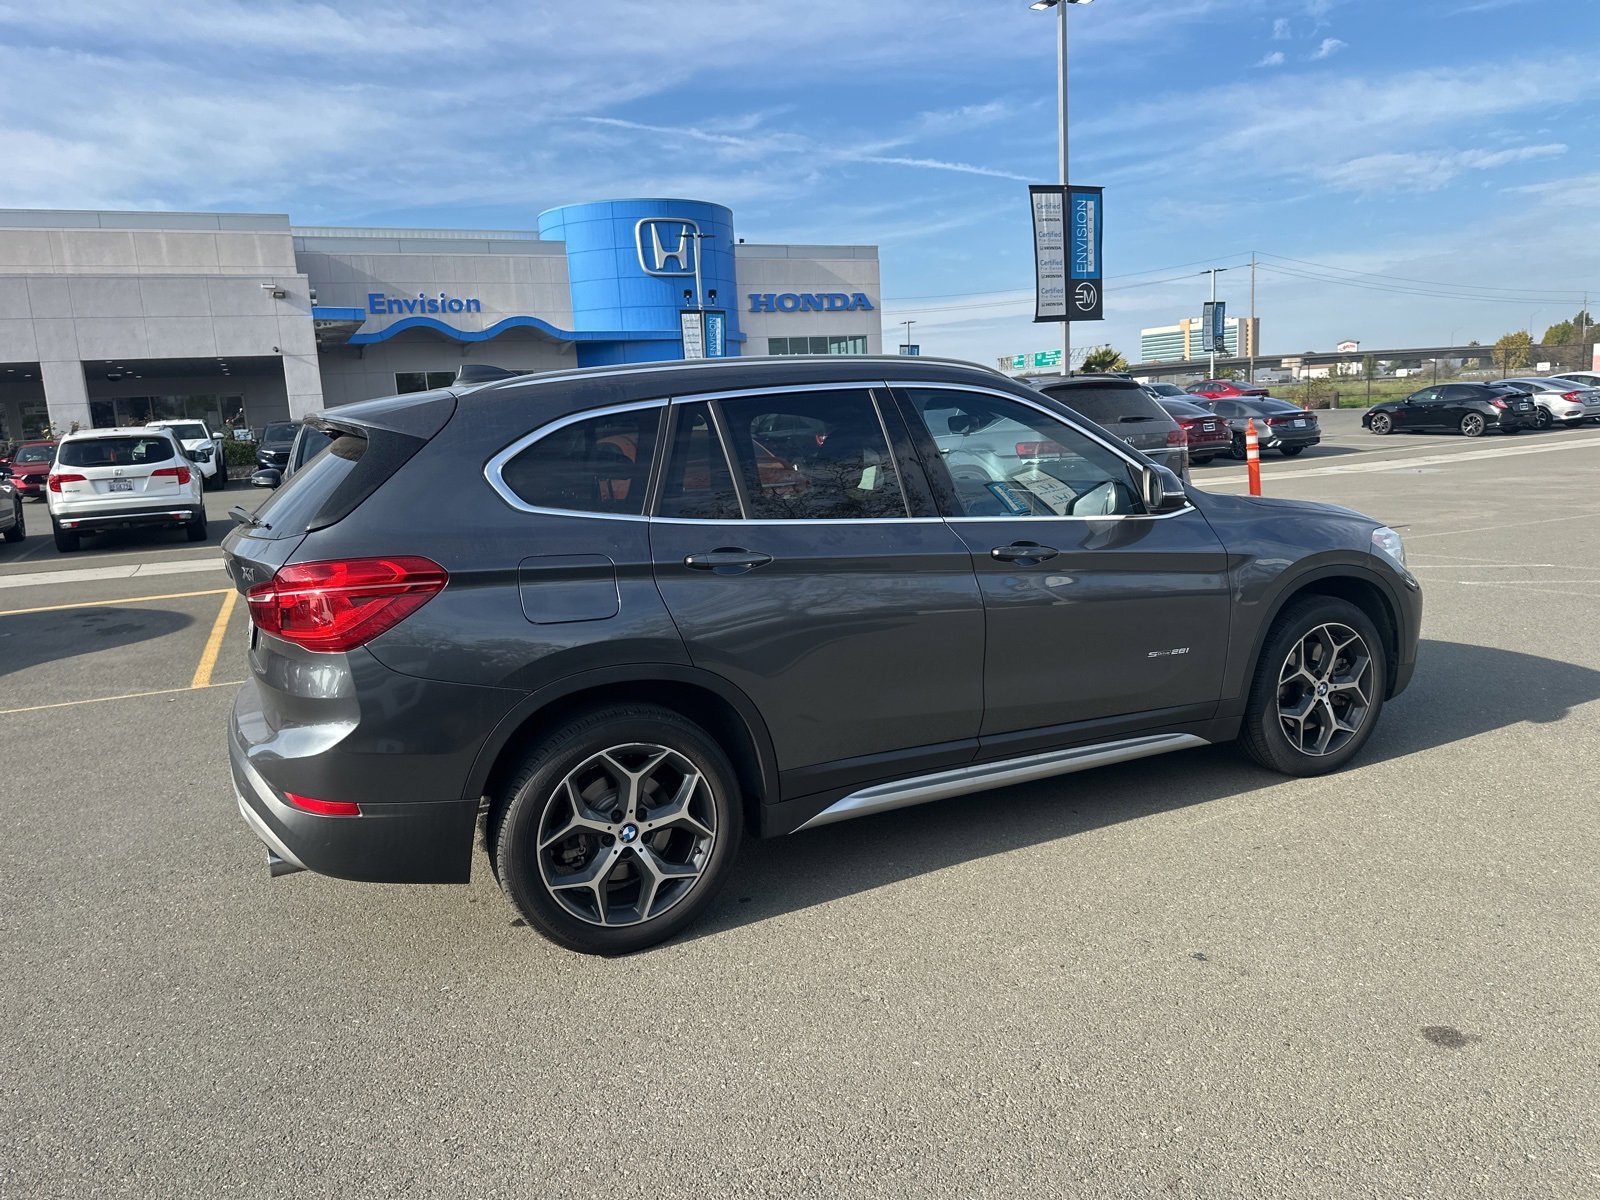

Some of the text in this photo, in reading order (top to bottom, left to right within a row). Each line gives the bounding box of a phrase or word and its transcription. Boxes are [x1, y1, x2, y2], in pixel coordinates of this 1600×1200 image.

[1076, 200, 1087, 273] ENVISION
[367, 293, 481, 314] Envision
[748, 292, 874, 312] HONDA
